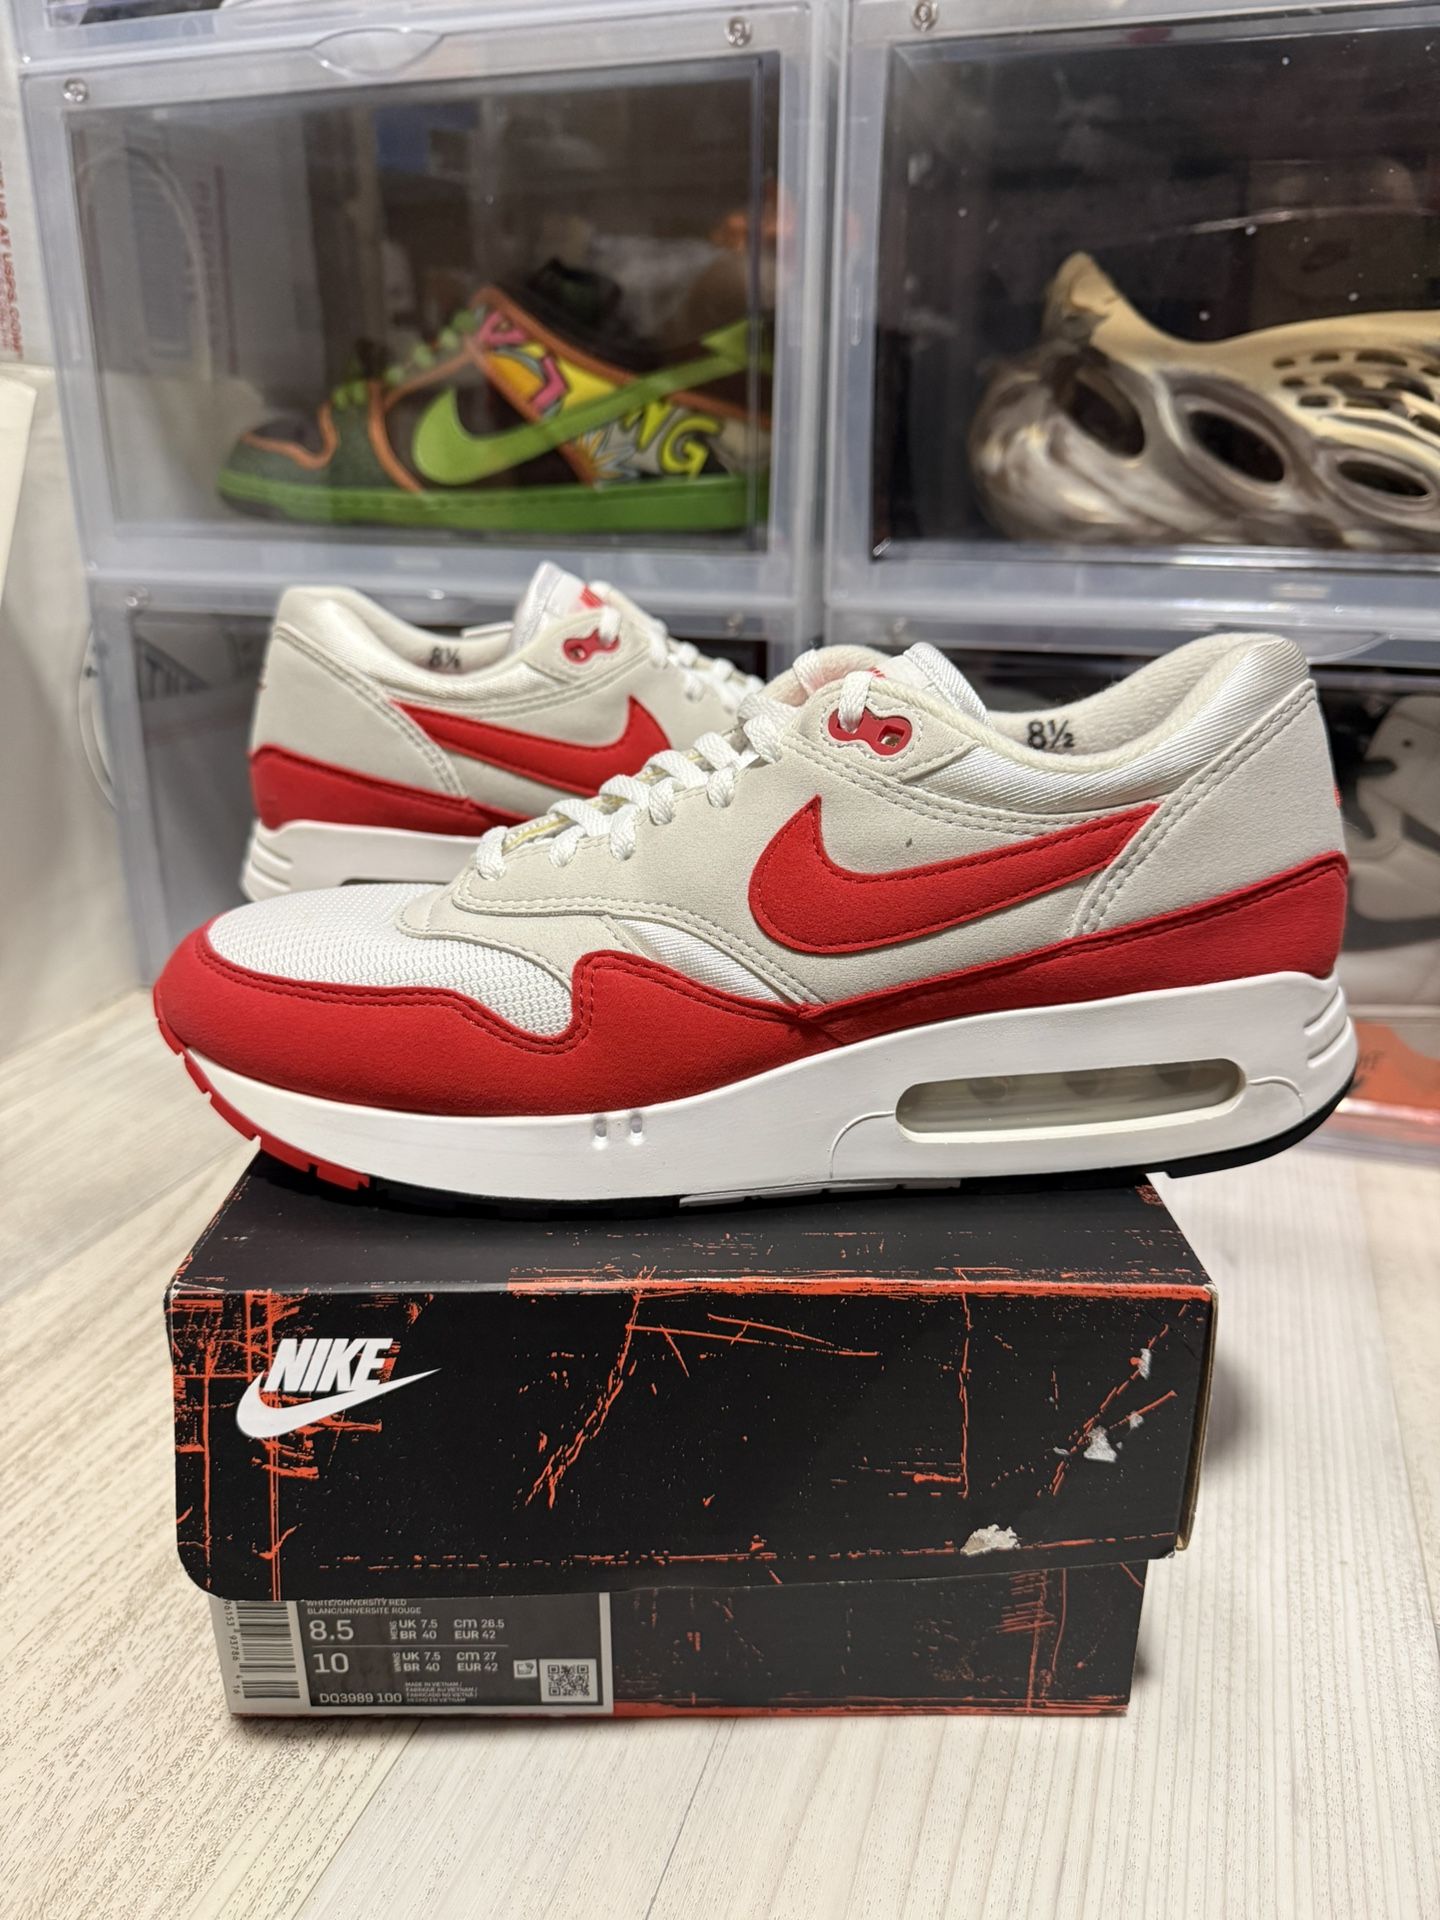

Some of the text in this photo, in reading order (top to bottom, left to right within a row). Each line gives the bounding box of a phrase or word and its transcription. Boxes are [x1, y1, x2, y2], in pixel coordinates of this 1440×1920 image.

[262, 1338, 394, 1392] NIKE
[306, 1606, 422, 1615] BLANC/UNIVERSITE ROUGE
[399, 1618, 505, 1629] UK 7.5 cm 26.5
[309, 1620, 354, 1640] 8.5
[400, 1630, 496, 1640] BR 40 EUR 42
[402, 1652, 497, 1661] UK 7.5 cm 27
[313, 1652, 349, 1673] 10
[403, 1662, 498, 1672] BR 40 EUR 42
[319, 1692, 402, 1704] DQ3989 100
